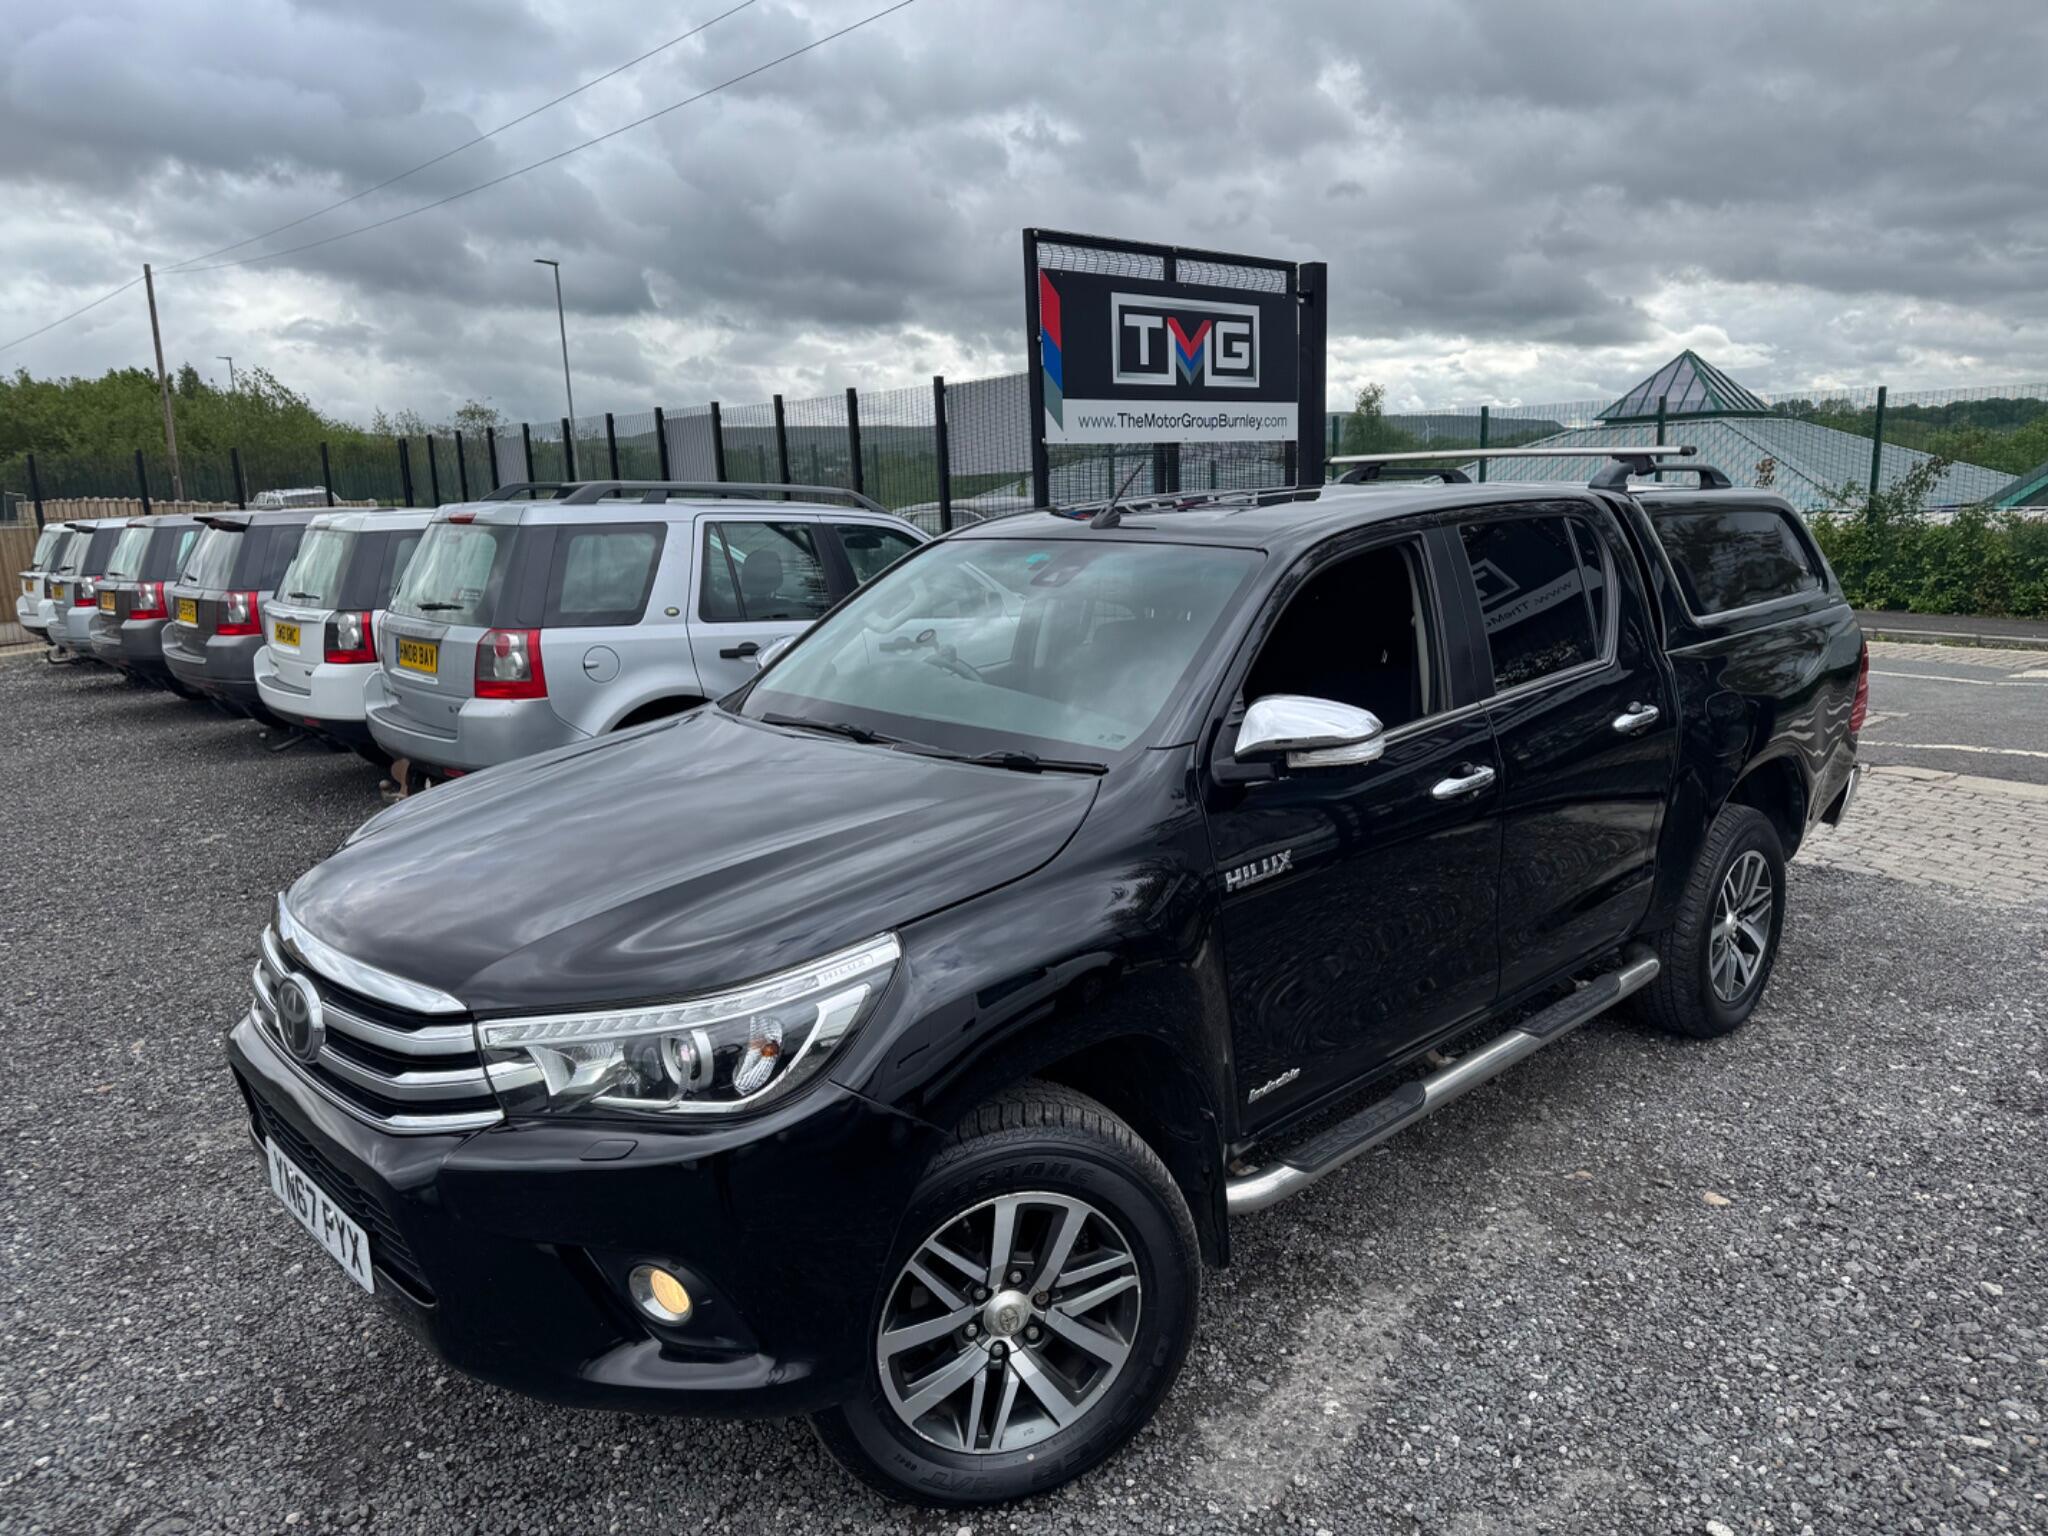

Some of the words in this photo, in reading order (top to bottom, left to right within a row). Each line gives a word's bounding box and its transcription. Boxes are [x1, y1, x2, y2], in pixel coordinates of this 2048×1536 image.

[1122, 312, 1251, 386] TMG
[1078, 412, 1288, 431] www.TheMotorGroupBurnley.com
[1225, 849, 1293, 893] HILUX
[273, 1150, 317, 1228] YN67
